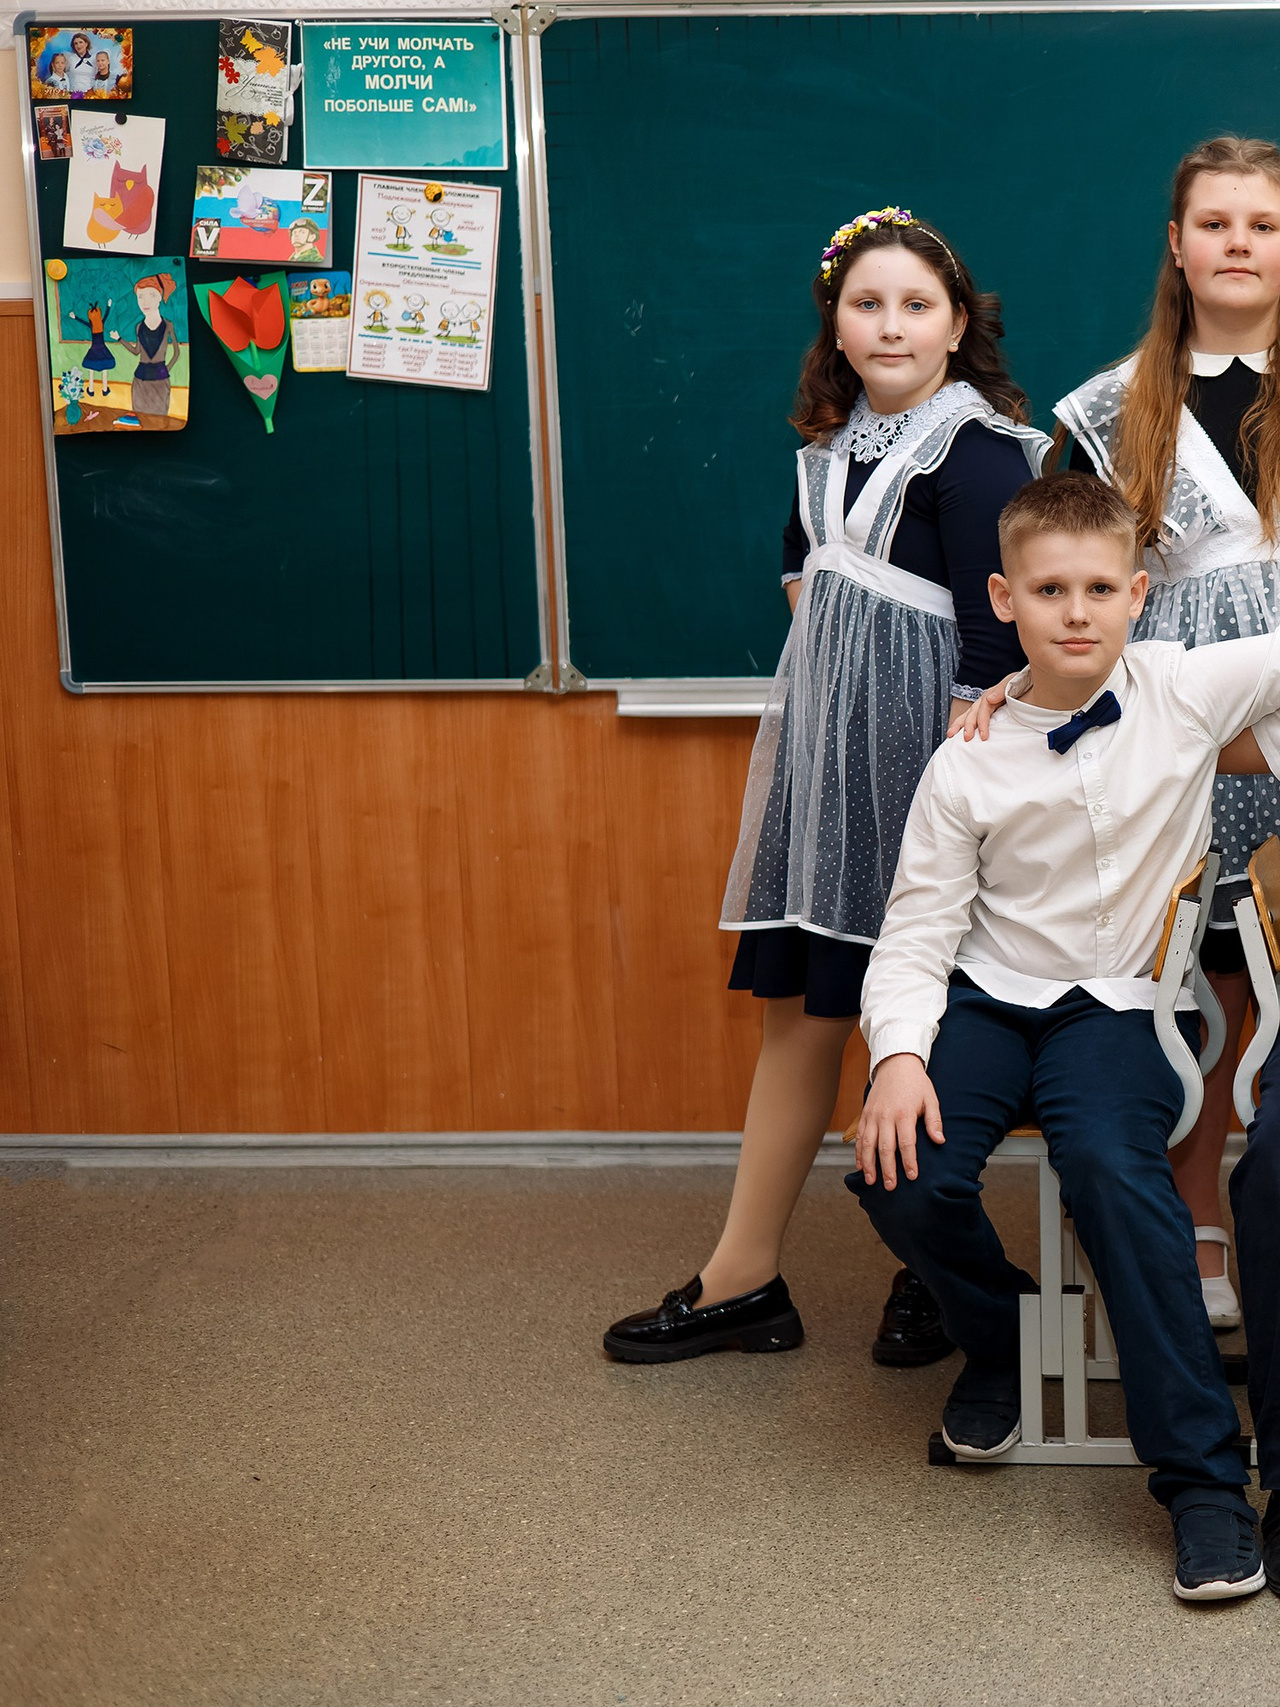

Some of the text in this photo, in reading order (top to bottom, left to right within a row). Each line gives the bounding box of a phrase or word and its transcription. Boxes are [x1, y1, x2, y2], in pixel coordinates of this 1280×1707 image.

[323, 37, 474, 51] «НЕ УЧИ МОЛЧАТЬ
[351, 56, 446, 70] ДРУГОГО, А
[365, 75, 433, 90] МОЛЧИ
[324, 97, 477, 113] ПОБОЛЬШЕ САМ!»
[303, 178, 326, 206] Z
[196, 226, 221, 250] V
